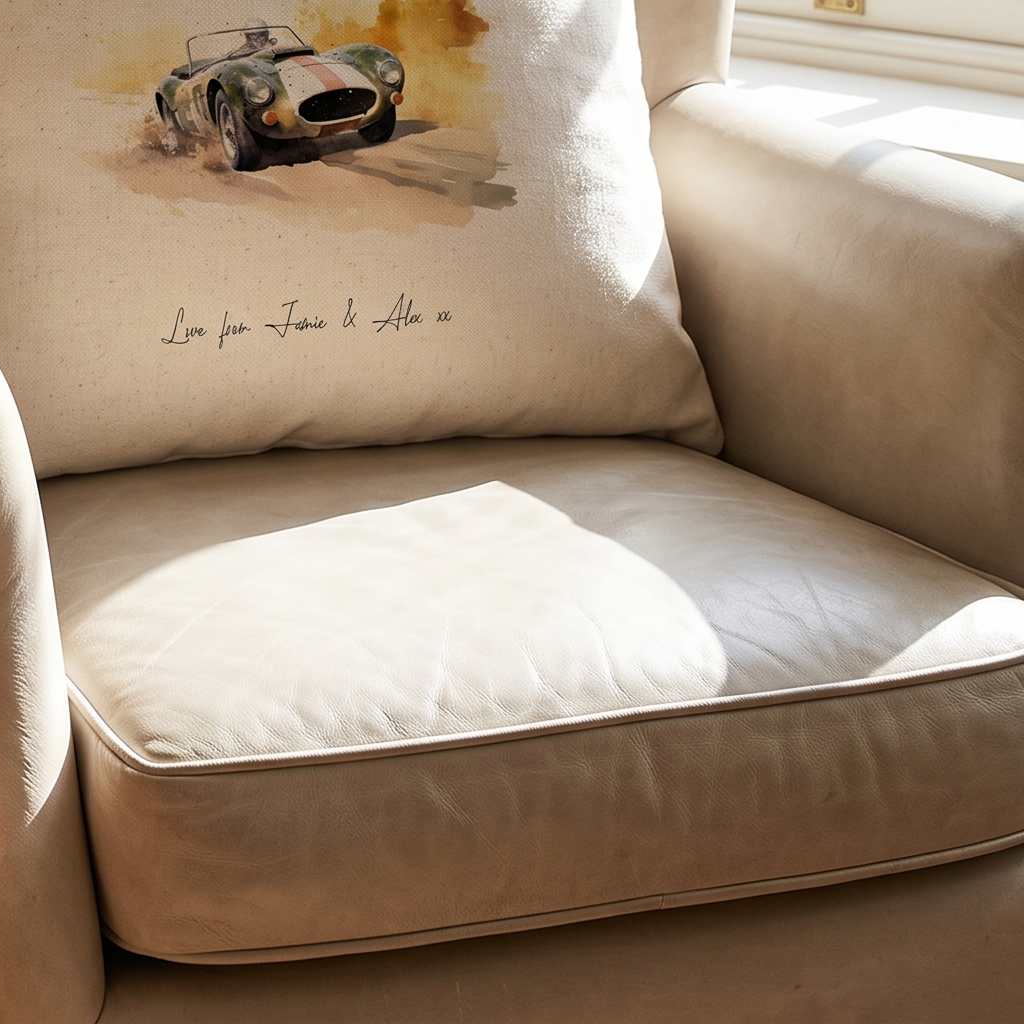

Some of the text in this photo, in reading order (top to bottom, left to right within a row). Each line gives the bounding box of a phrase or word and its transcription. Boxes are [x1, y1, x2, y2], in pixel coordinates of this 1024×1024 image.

[342, 298, 357, 328] &
[372, 292, 424, 333] Alex
[436, 310, 453, 323] xx
